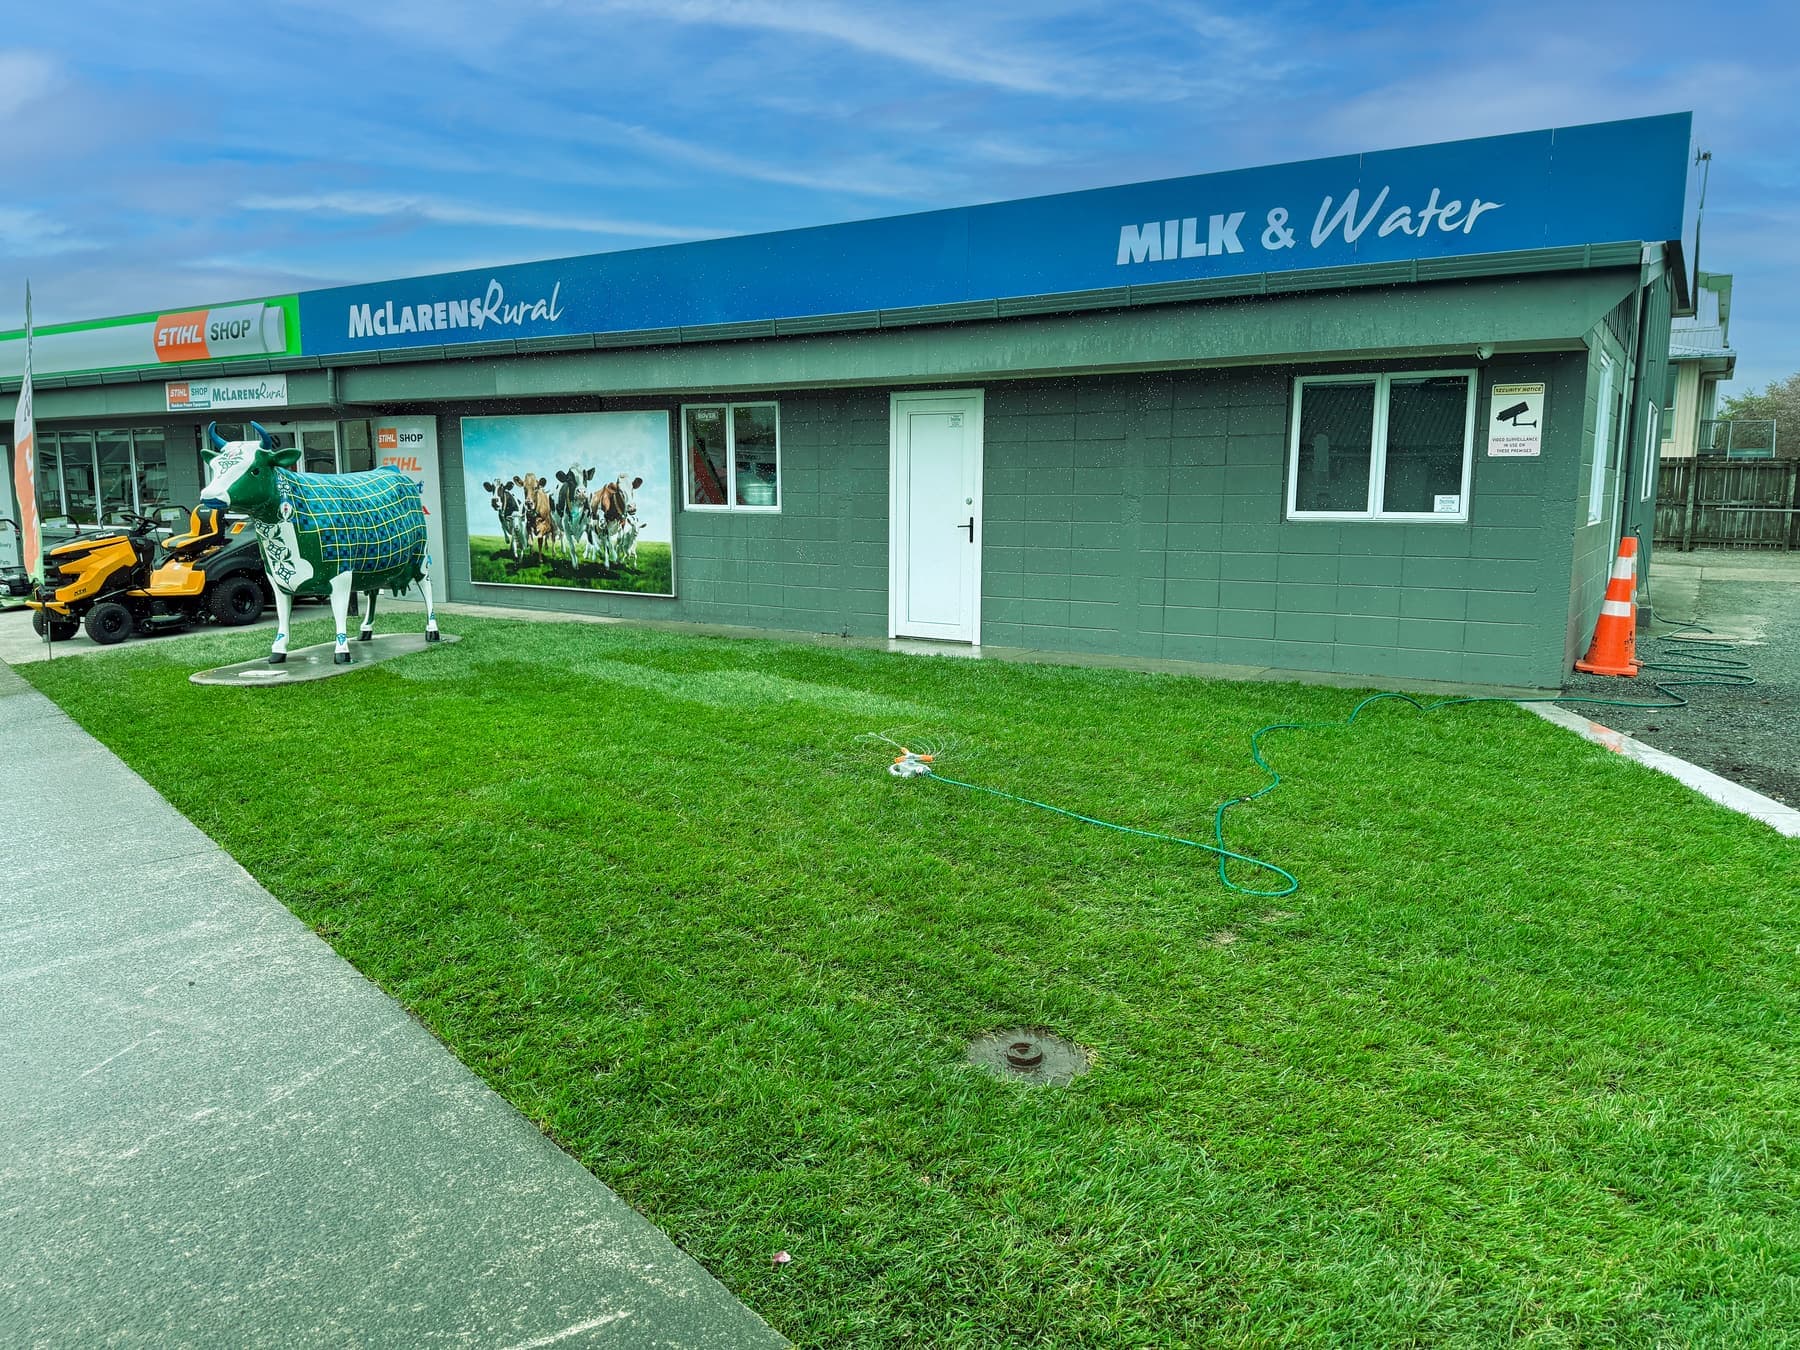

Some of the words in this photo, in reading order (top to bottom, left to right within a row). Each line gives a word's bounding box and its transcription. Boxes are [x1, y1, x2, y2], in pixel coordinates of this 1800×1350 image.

[1116, 211, 1246, 266] MILK
[1261, 207, 1297, 251] &
[1310, 185, 1505, 249] Water
[157, 324, 203, 348] STIHL
[210, 319, 252, 342] SHOP
[169, 389, 187, 398] STIHL
[191, 387, 208, 397] SHOP
[378, 434, 396, 443] STIHL
[399, 433, 424, 443] SHOP
